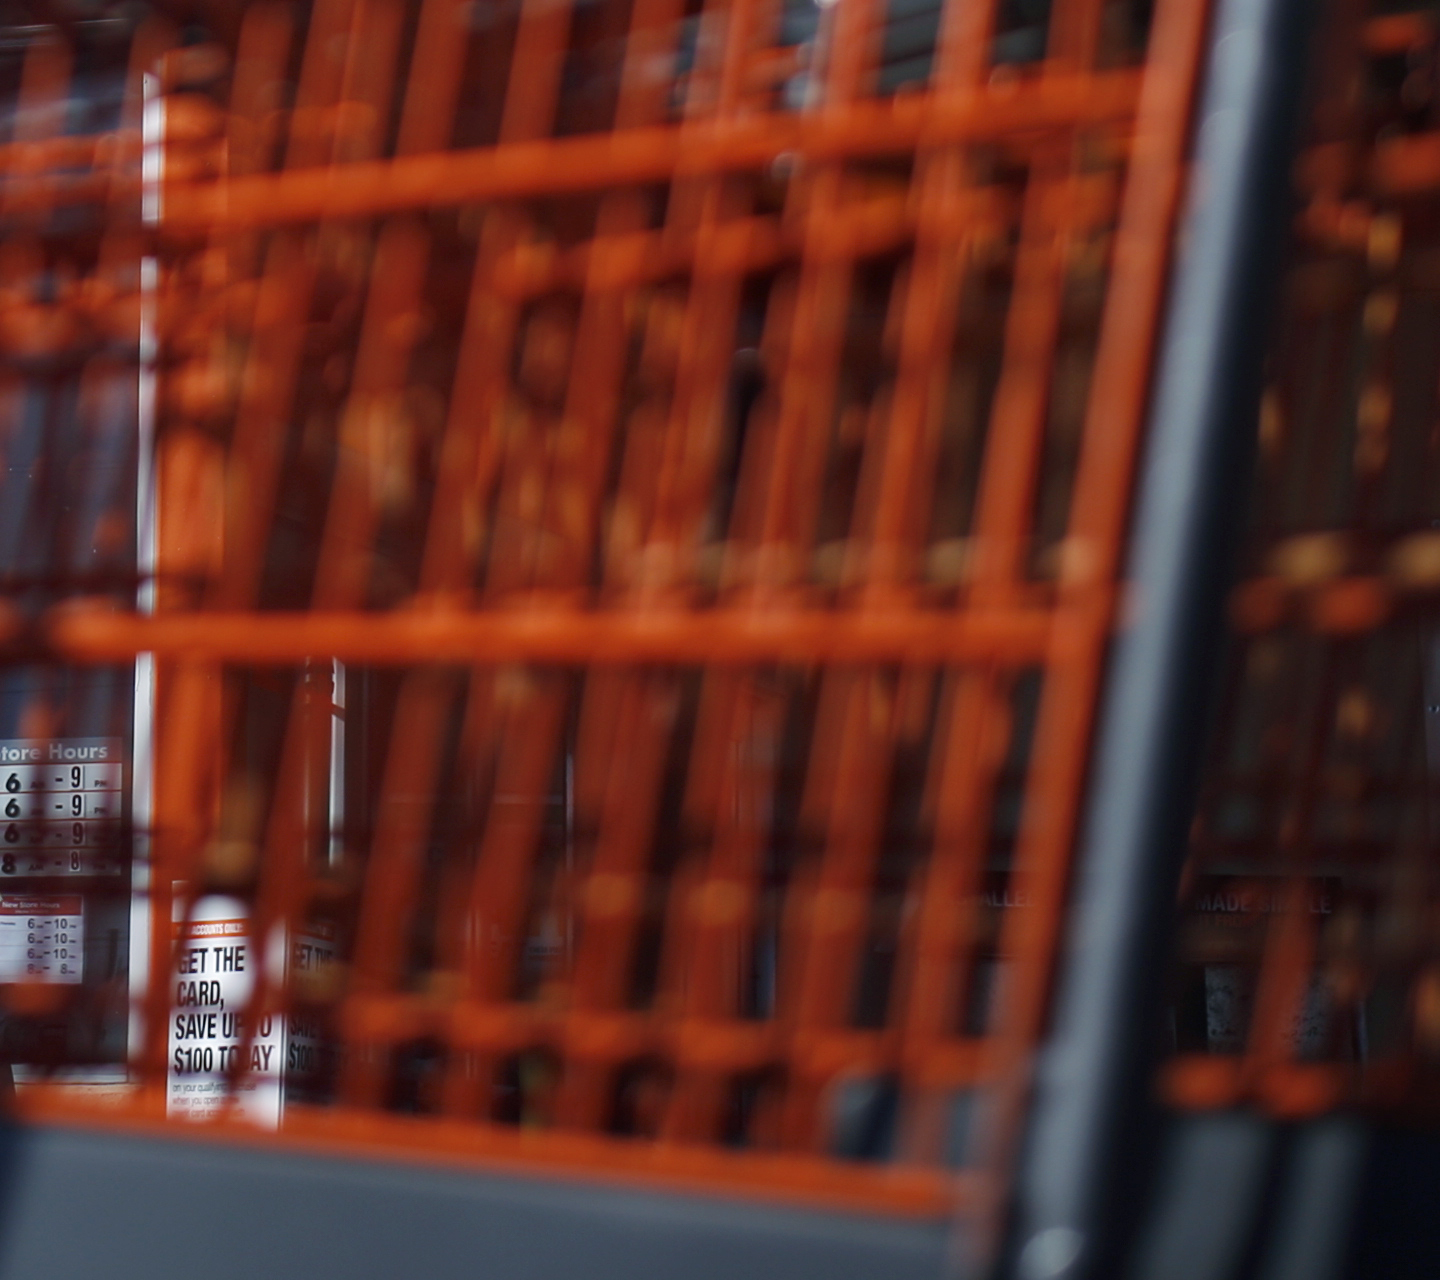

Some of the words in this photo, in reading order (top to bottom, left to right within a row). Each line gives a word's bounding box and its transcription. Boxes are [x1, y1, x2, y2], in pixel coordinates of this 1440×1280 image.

[49, 742, 108, 760] Hours
[5, 772, 22, 794] 6
[71, 765, 82, 789] 9
[5, 797, 20, 818] 6
[71, 794, 82, 817] 9
[4, 822, 19, 844] 6
[72, 822, 84, 845] 9
[1, 852, 17, 875] 8
[70, 850, 80, 871] 8
[1195, 892, 1252, 913] MADE
[1260, 894, 1333, 915] SILE
[27, 918, 36, 929] 6
[53, 918, 68, 929] 10
[27, 932, 36, 944] 6
[53, 932, 68, 944] 10
[27, 947, 36, 959] 6
[52, 947, 68, 960] 10
[178, 947, 209, 974] GET
[213, 945, 246, 973] THE
[293, 942, 313, 971] GET
[60, 963, 69, 975] 8
[176, 980, 225, 1011] CARD,
[175, 1013, 217, 1040] SAVE
[222, 1011, 244, 1038] UP
[174, 1045, 214, 1077] $100
